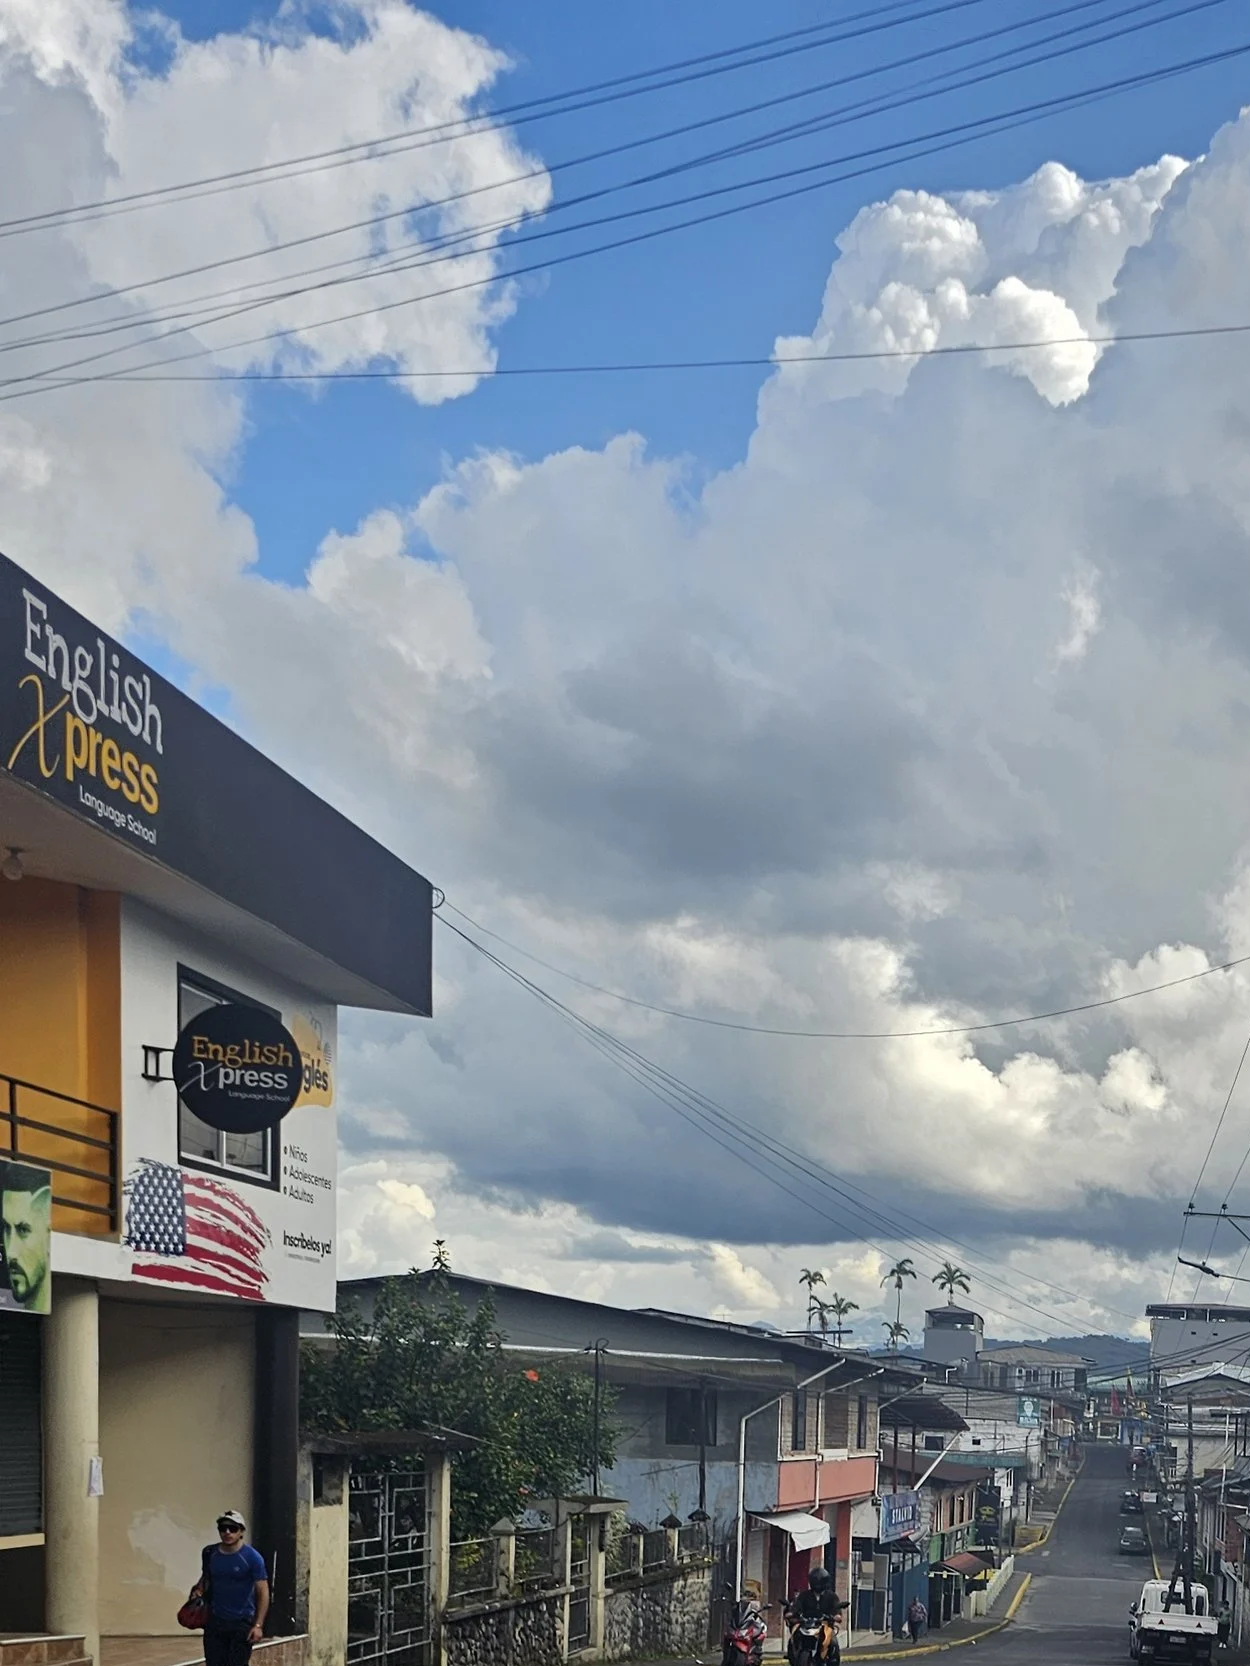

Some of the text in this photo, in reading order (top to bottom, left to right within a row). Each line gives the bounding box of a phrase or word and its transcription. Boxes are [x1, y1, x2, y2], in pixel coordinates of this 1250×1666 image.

[22, 588, 163, 754] English
[79, 785, 157, 846] Language School
[192, 1036, 293, 1069] English
[303, 1059, 329, 1094] glés
[228, 1090, 291, 1103] Language School
[289, 1165, 332, 1191] Adolescentes
[289, 1185, 314, 1204] Adultos
